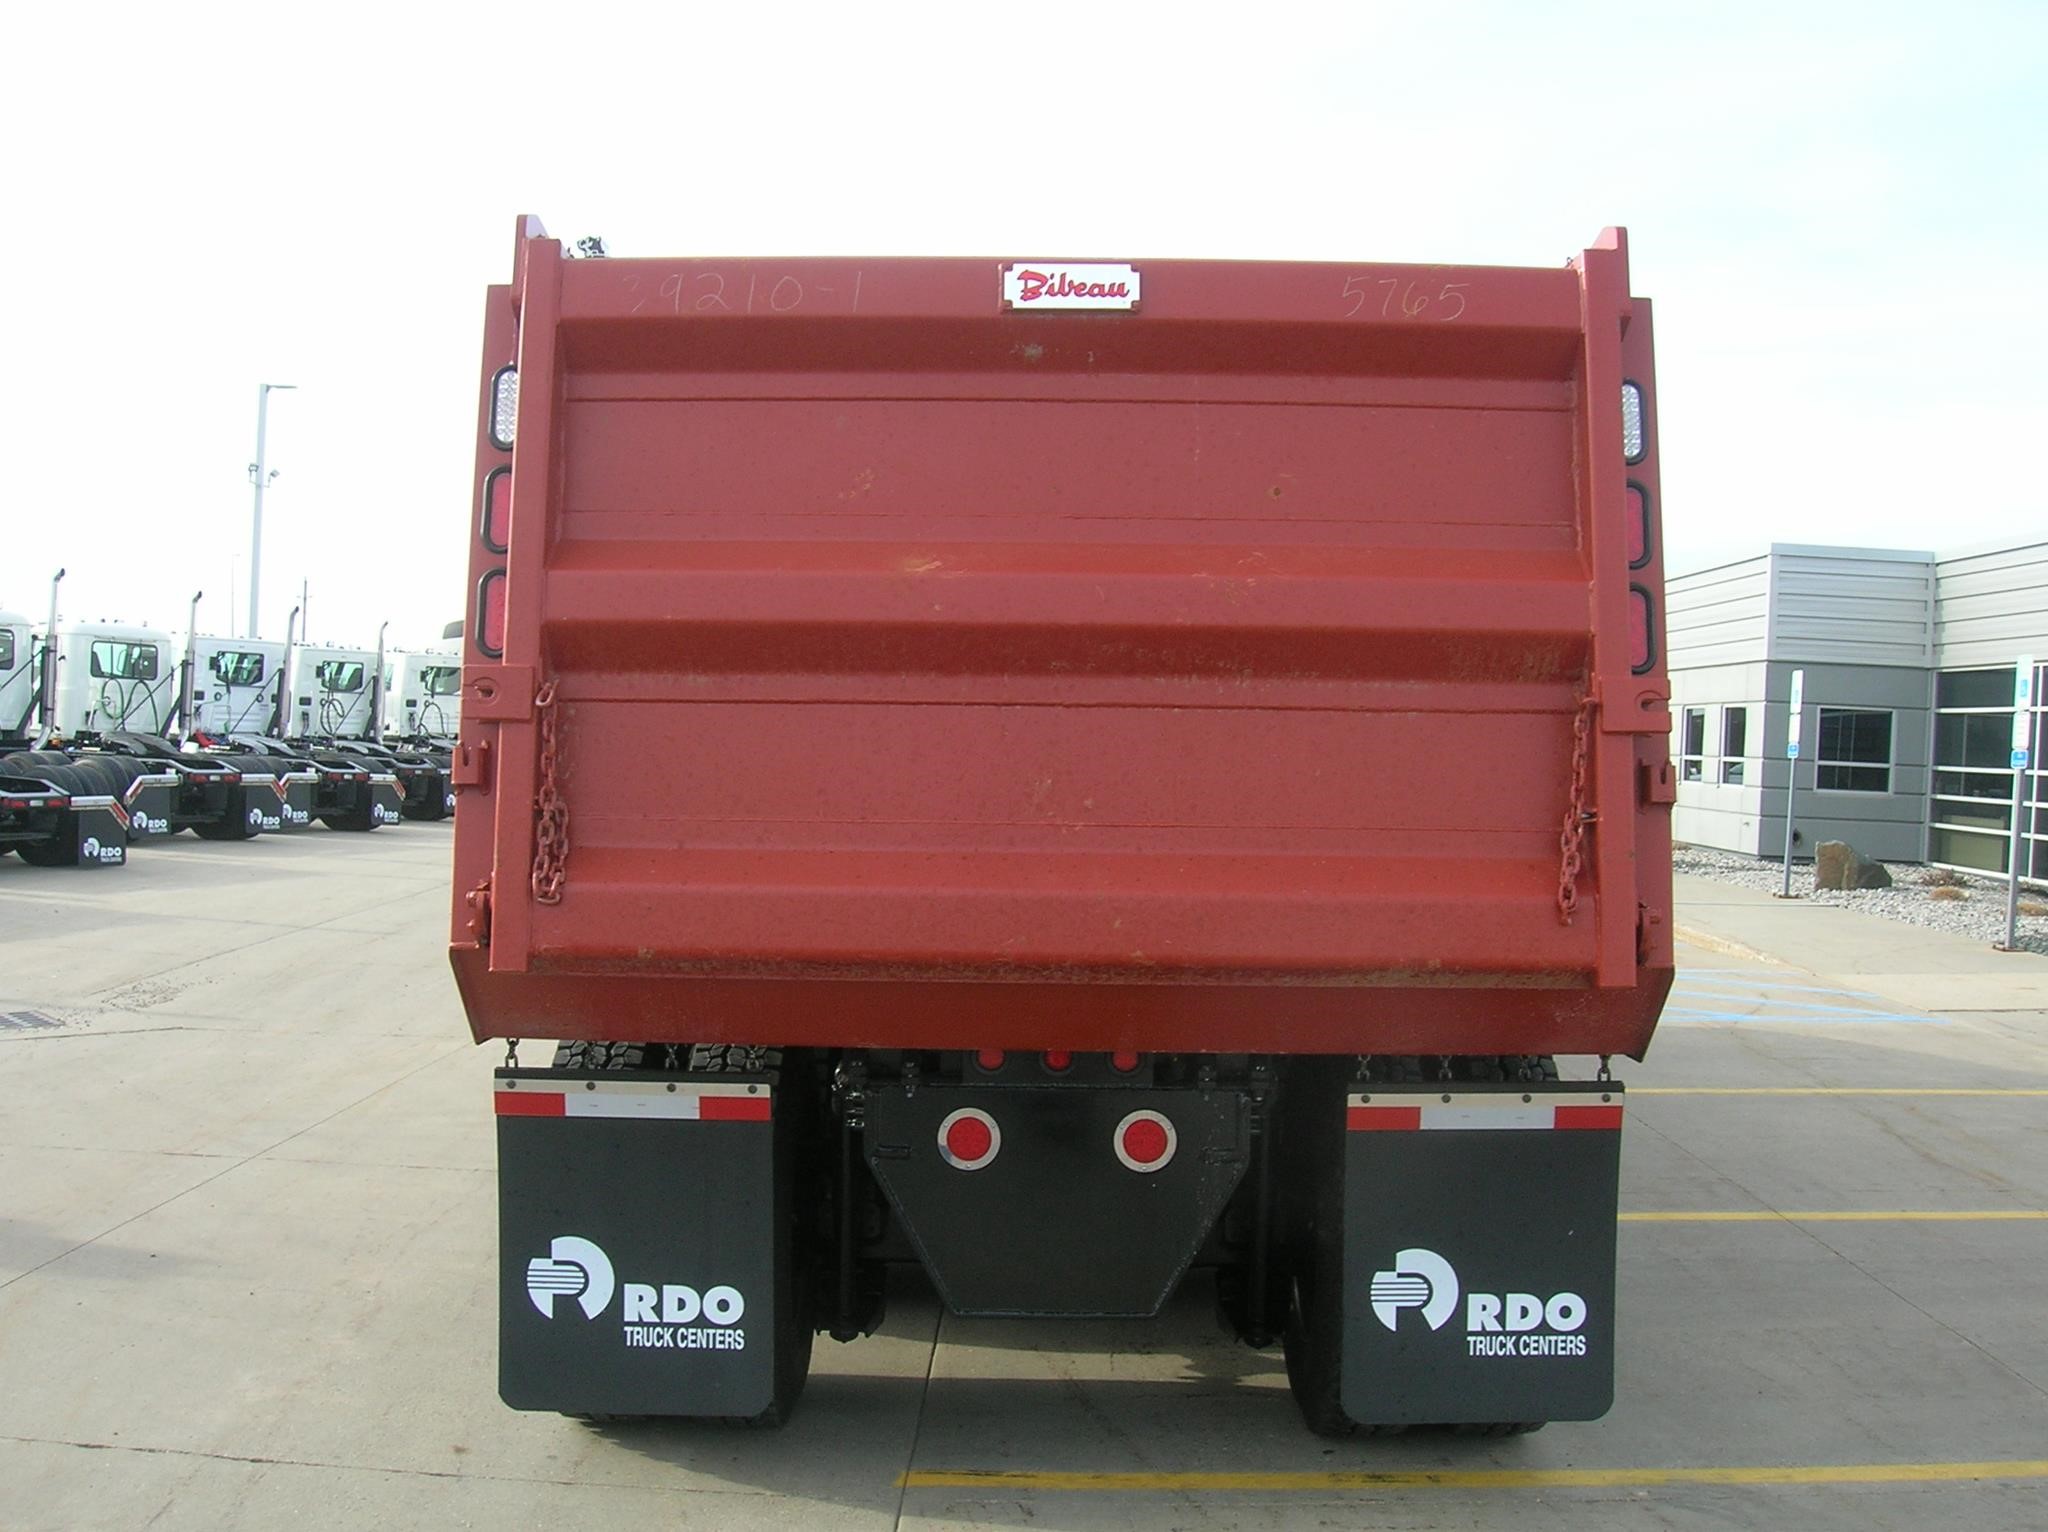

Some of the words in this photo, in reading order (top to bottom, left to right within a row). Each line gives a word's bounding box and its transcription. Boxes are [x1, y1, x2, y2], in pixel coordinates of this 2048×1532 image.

[1016, 269, 1130, 302] Bibeau
[1341, 274, 1471, 321] 5765
[148, 818, 168, 828] RDO
[262, 816, 281, 825] RDO
[100, 846, 122, 857] RDO
[623, 1283, 745, 1325] RDO
[1467, 1292, 1587, 1331] RDO
[623, 1326, 674, 1348] TRUCK
[676, 1327, 745, 1350] CENTERS
[1467, 1335, 1517, 1356] TRUCK
[1519, 1335, 1587, 1356] CENTERS
